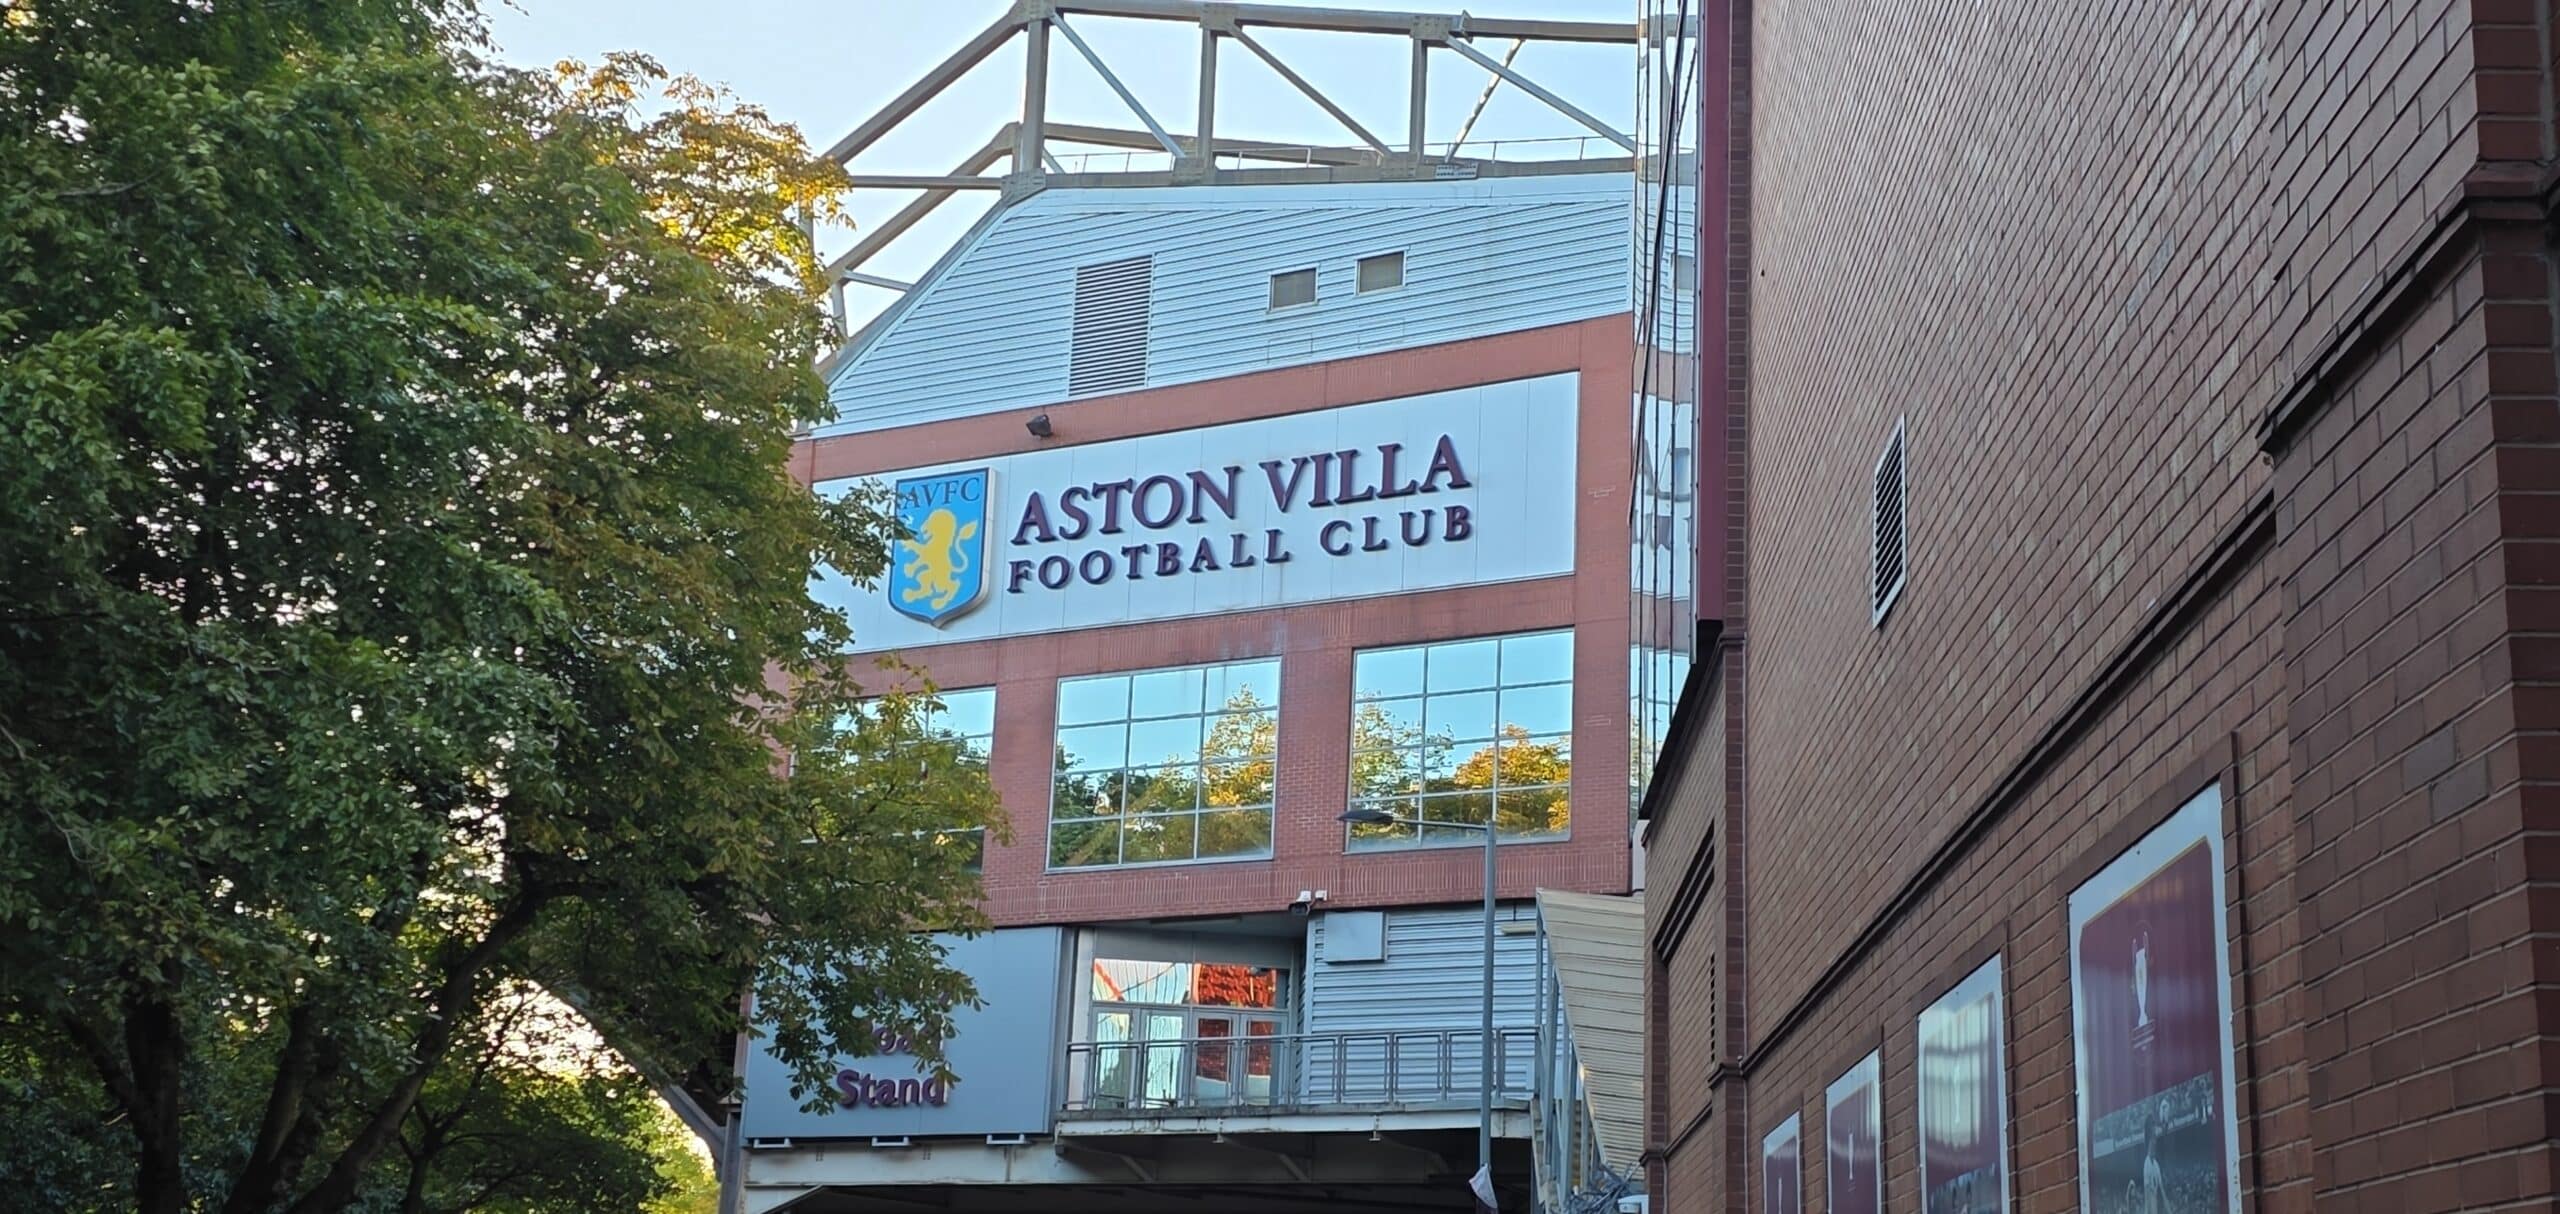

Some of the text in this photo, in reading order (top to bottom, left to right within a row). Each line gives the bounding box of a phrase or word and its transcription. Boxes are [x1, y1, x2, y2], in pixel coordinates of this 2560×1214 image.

[902, 477, 980, 510] AVFC
[1011, 434, 1473, 546] ASTON VILLA
[1007, 506, 1473, 594] FOOTBALL CLUB
[836, 1068, 947, 1109] Stand
